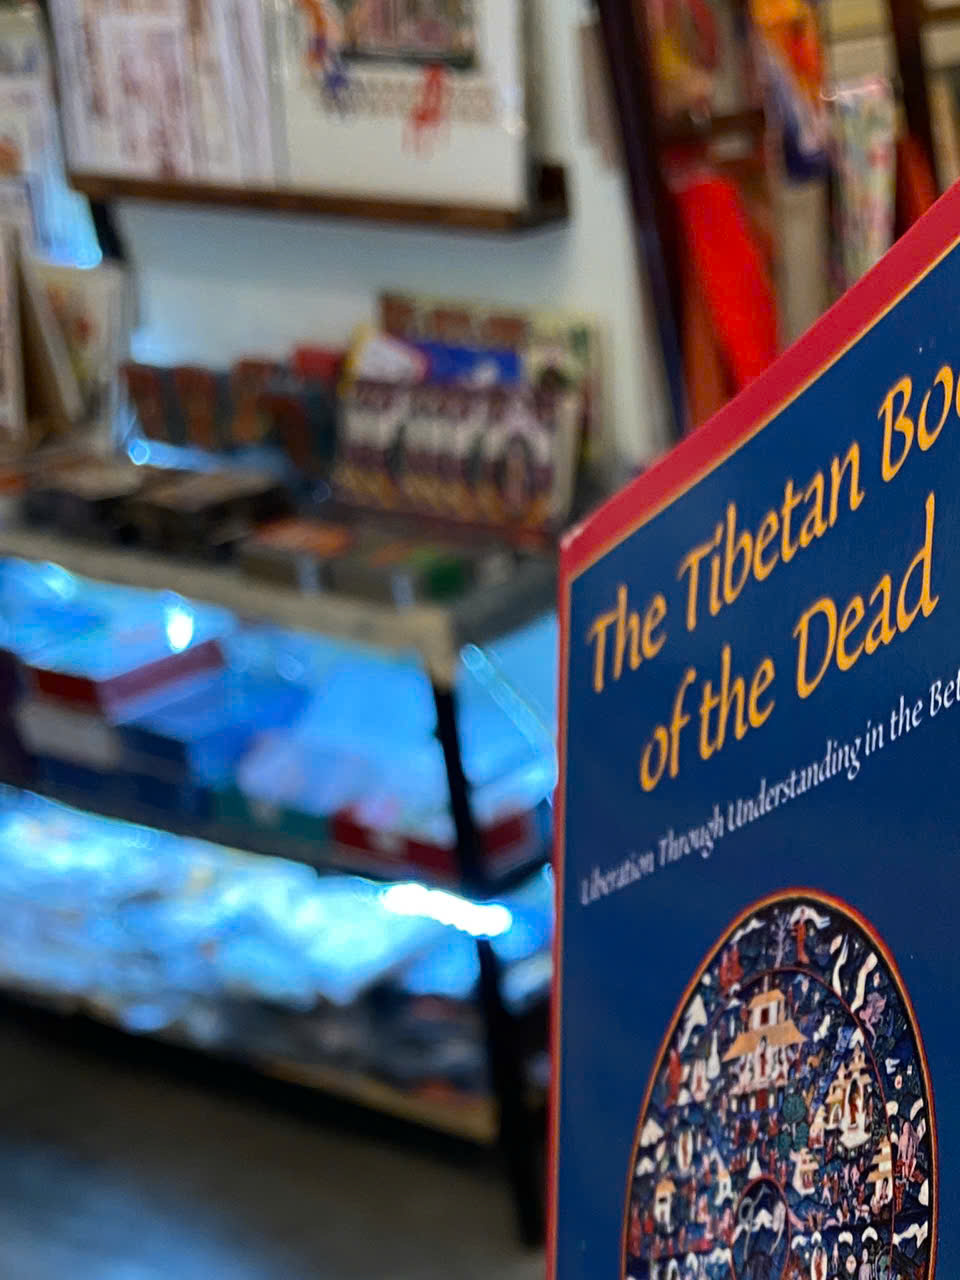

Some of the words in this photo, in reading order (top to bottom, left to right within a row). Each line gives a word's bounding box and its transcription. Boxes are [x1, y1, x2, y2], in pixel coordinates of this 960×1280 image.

[585, 584, 668, 694] The
[676, 441, 865, 633] Tibetan
[638, 667, 697, 793] of
[700, 643, 776, 761] the
[792, 490, 940, 700] Dead
[580, 852, 656, 906] Liberation
[658, 804, 726, 866] Through
[726, 735, 862, 830] Understanding
[864, 725, 886, 757] in
[890, 695, 924, 743] the
